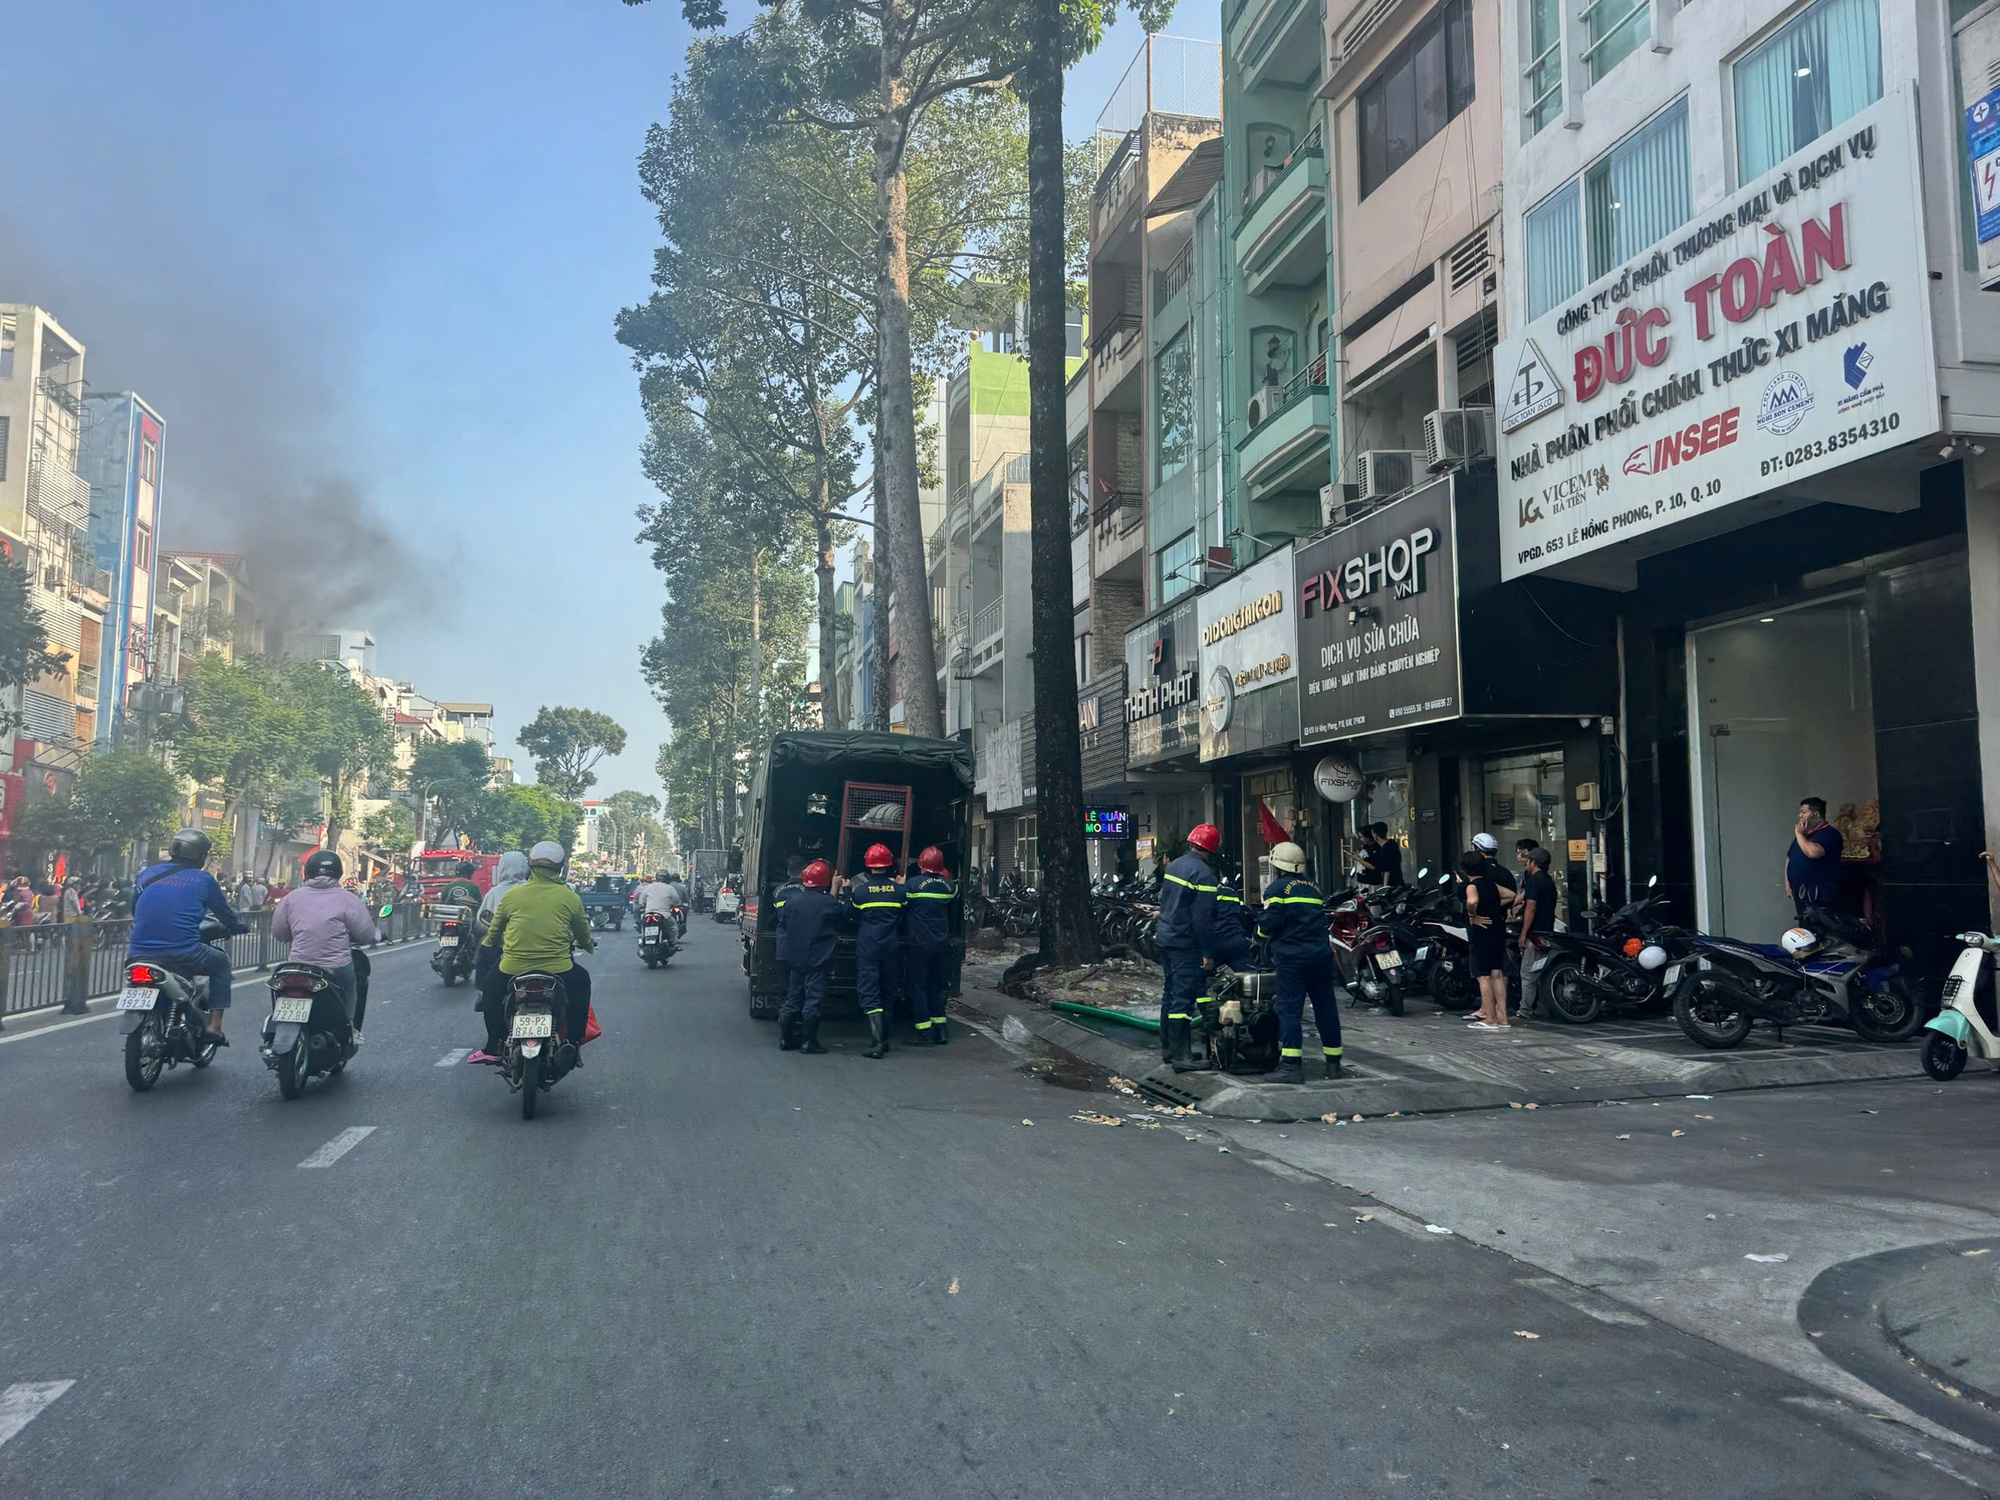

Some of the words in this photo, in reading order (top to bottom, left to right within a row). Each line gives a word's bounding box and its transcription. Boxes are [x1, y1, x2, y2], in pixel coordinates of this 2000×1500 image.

[1557, 308, 1589, 335] CÔNG
[1592, 289, 1608, 315] TY
[1611, 268, 1629, 302] CỔ
[1632, 251, 1669, 290] PHẦN
[1674, 212, 1734, 265] THƯƠNG
[1737, 191, 1769, 227] MẠI
[1772, 172, 1796, 204] VÀ
[1799, 145, 1843, 190] DỊCH
[1848, 125, 1875, 158] VỤ
[1573, 307, 1670, 402] ĐỨC
[1685, 202, 1850, 340] TOÀN
[1510, 443, 1543, 480] NHÀ
[1546, 423, 1591, 463] PHÂN
[1595, 390, 1639, 440] PHỐI
[1642, 369, 1702, 417] CHÍNH
[1708, 336, 1769, 387] THỨC
[1775, 321, 1801, 357] XI
[1807, 281, 1889, 342] MĂNG
[1508, 415, 1520, 427] DUC
[1520, 406, 1536, 419] TOAN
[1757, 414, 1773, 426] NGHI
[1787, 396, 1814, 412] CEMENT
[1653, 407, 1740, 474] INSEE
[1760, 456, 1783, 477] ĐT:
[1785, 412, 1900, 468] 0283.8354310
[1542, 468, 1593, 504] VICEM
[1552, 502, 1565, 515] HÀ
[1567, 492, 1587, 509] TIÊN
[1518, 545, 1544, 564] VPGD.
[1546, 536, 1564, 553] 653
[1567, 527, 1579, 546] LÊ
[1581, 518, 1609, 541] HỒNG
[1612, 504, 1652, 530] PHONG,
[1655, 500, 1667, 515] P.
[1669, 492, 1686, 509] 10,
[1690, 486, 1704, 502] Q.
[1706, 478, 1721, 496] 10
[1301, 527, 1434, 618] FIXSHOP
[1321, 641, 1344, 671] DỊCH
[1347, 635, 1361, 663] VỤ
[1364, 622, 1386, 655] SỬA
[1389, 614, 1420, 648] CHỮA
[1320, 777, 1361, 788] FIXSHOP
[1084, 810, 1096, 821] LÊ
[1085, 823, 1123, 833] MOBILE
[126, 989, 153, 999] 59-H2
[275, 1010, 307, 1021] 727.80
[519, 1017, 546, 1026] 59-P2
[515, 1026, 549, 1037] 874.80
